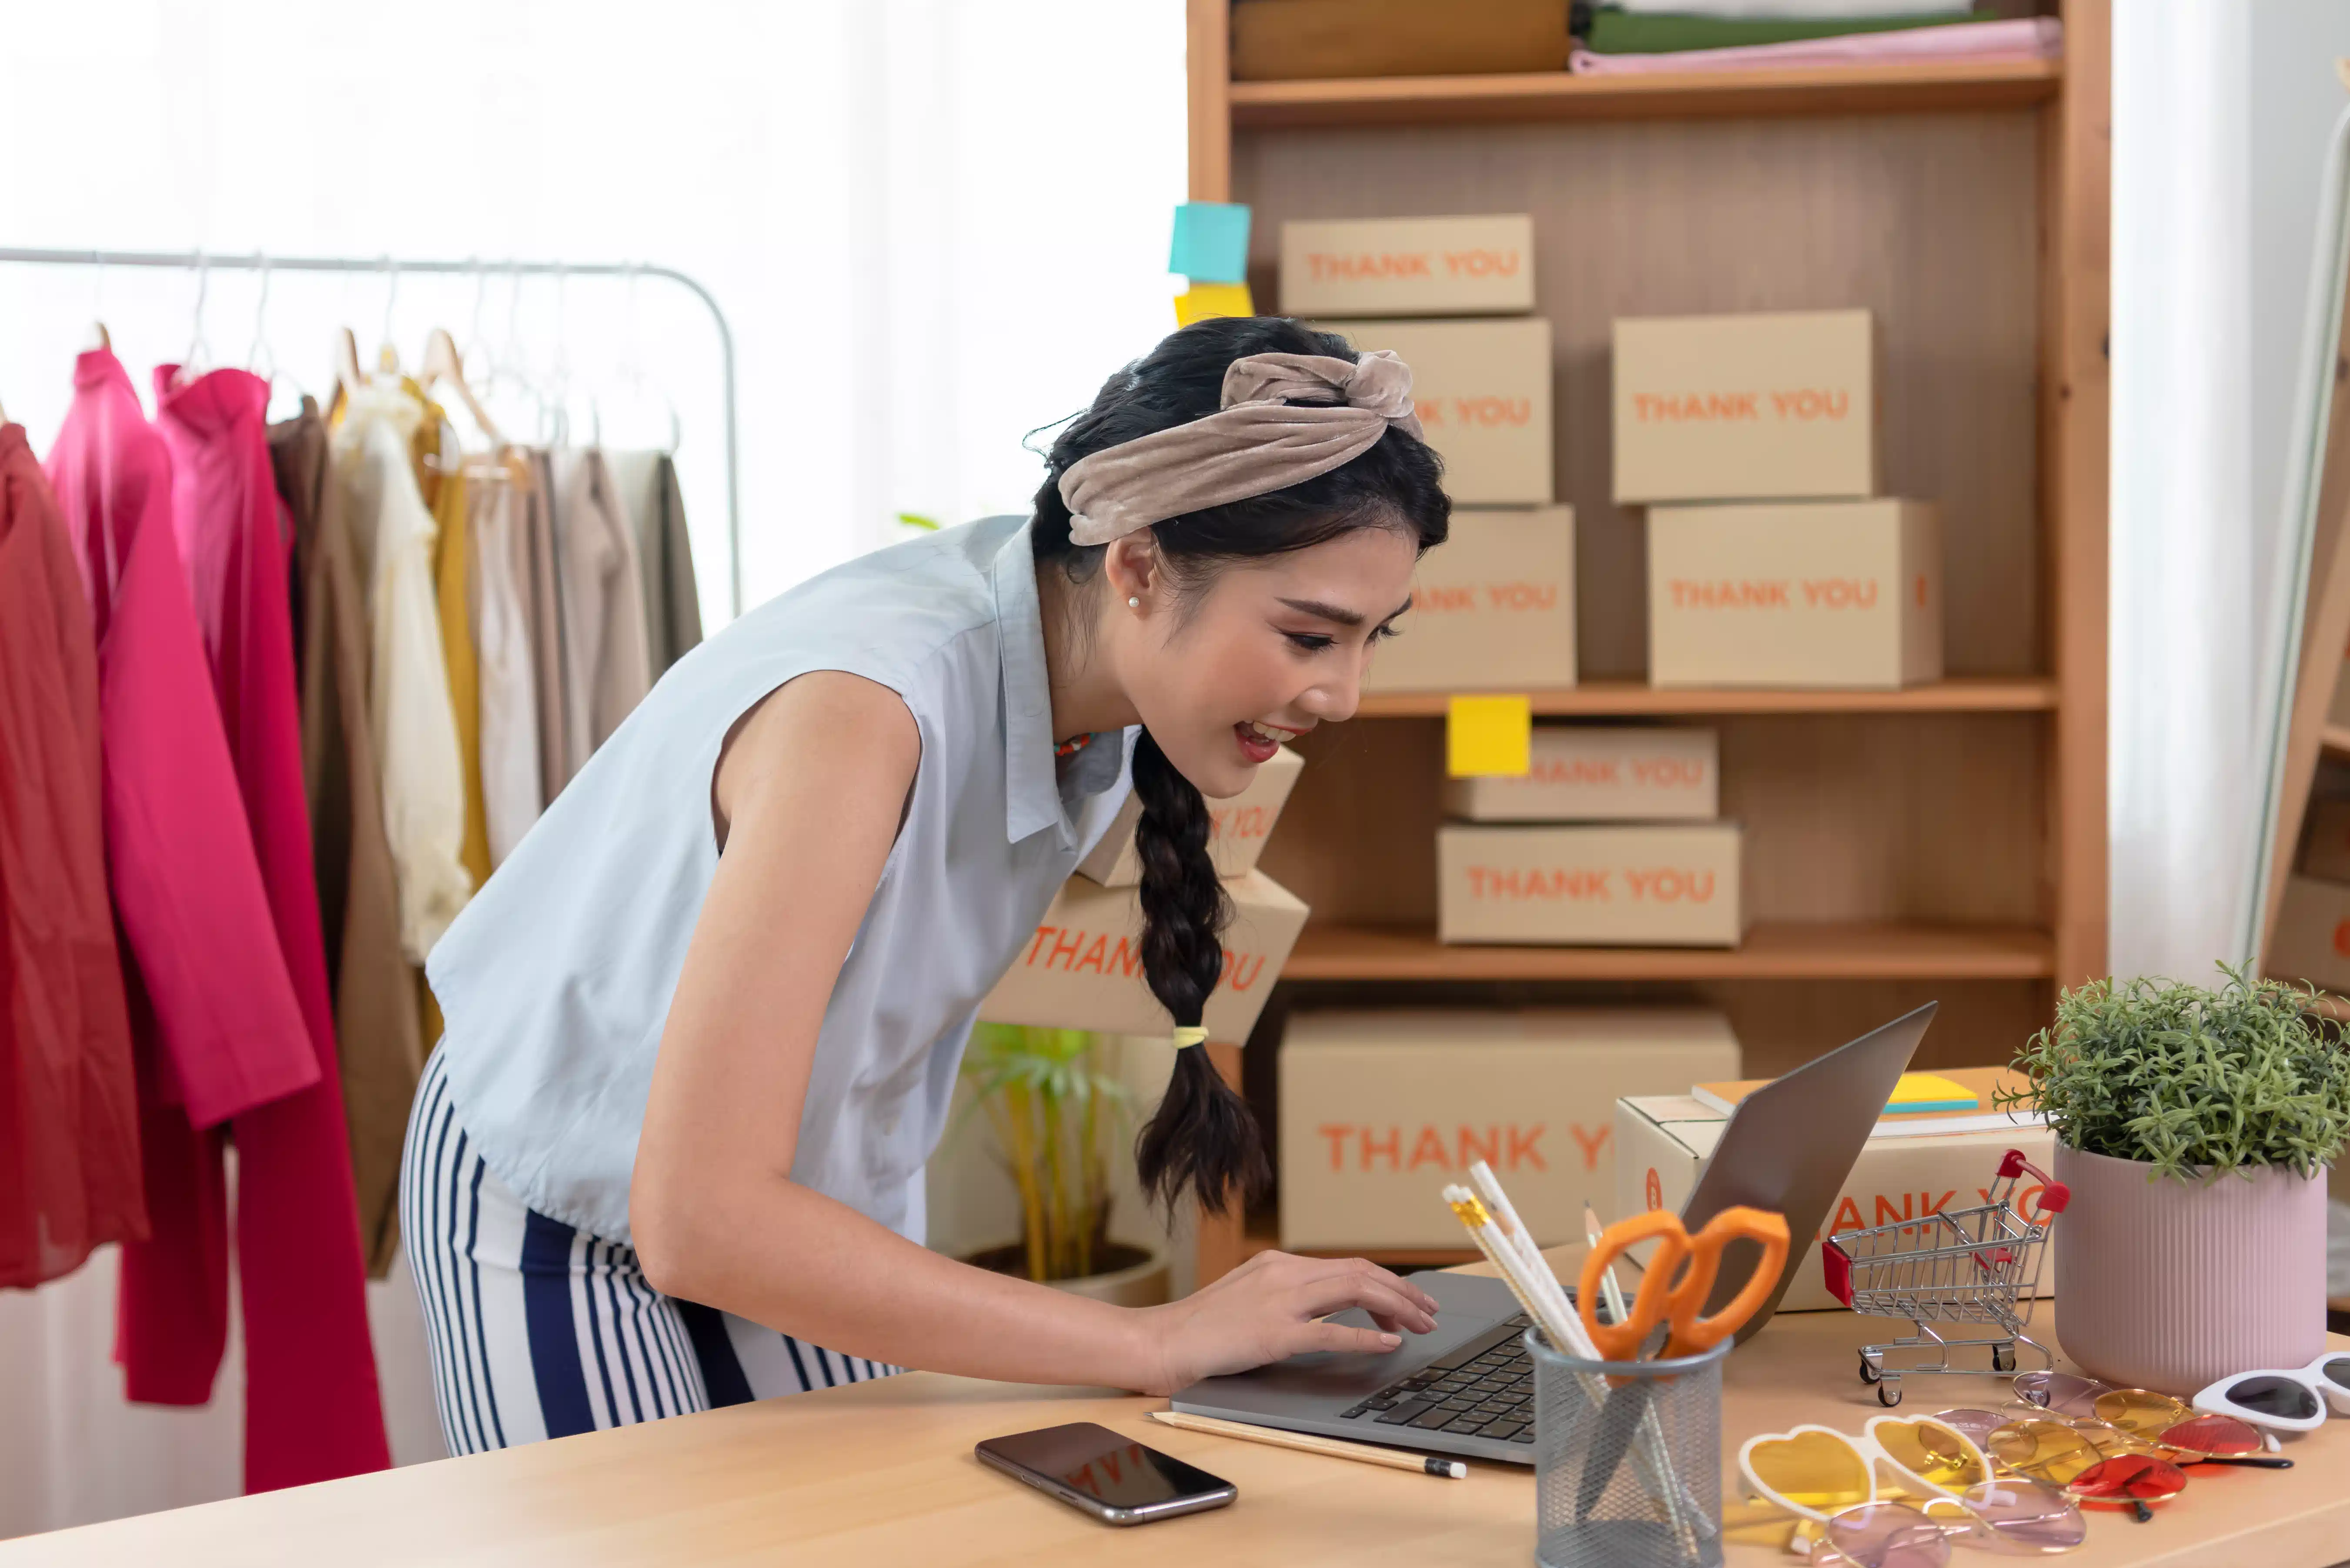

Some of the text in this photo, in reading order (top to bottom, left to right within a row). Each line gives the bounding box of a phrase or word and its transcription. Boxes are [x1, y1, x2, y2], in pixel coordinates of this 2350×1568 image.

[1306, 247, 1520, 281] THANK YOU
[1454, 394, 1532, 429] YOU
[1631, 388, 1850, 424] THANK YOU
[1412, 582, 1558, 613] ANK YOU
[1668, 577, 1880, 611] THANK YOU
[1508, 756, 1705, 789] HANK YOU
[1465, 865, 1716, 904] THANK YOU
[1026, 925, 1267, 991] THAN OU
[1318, 1122, 1548, 1173] THANK
[1815, 1190, 1957, 1241] ANK
